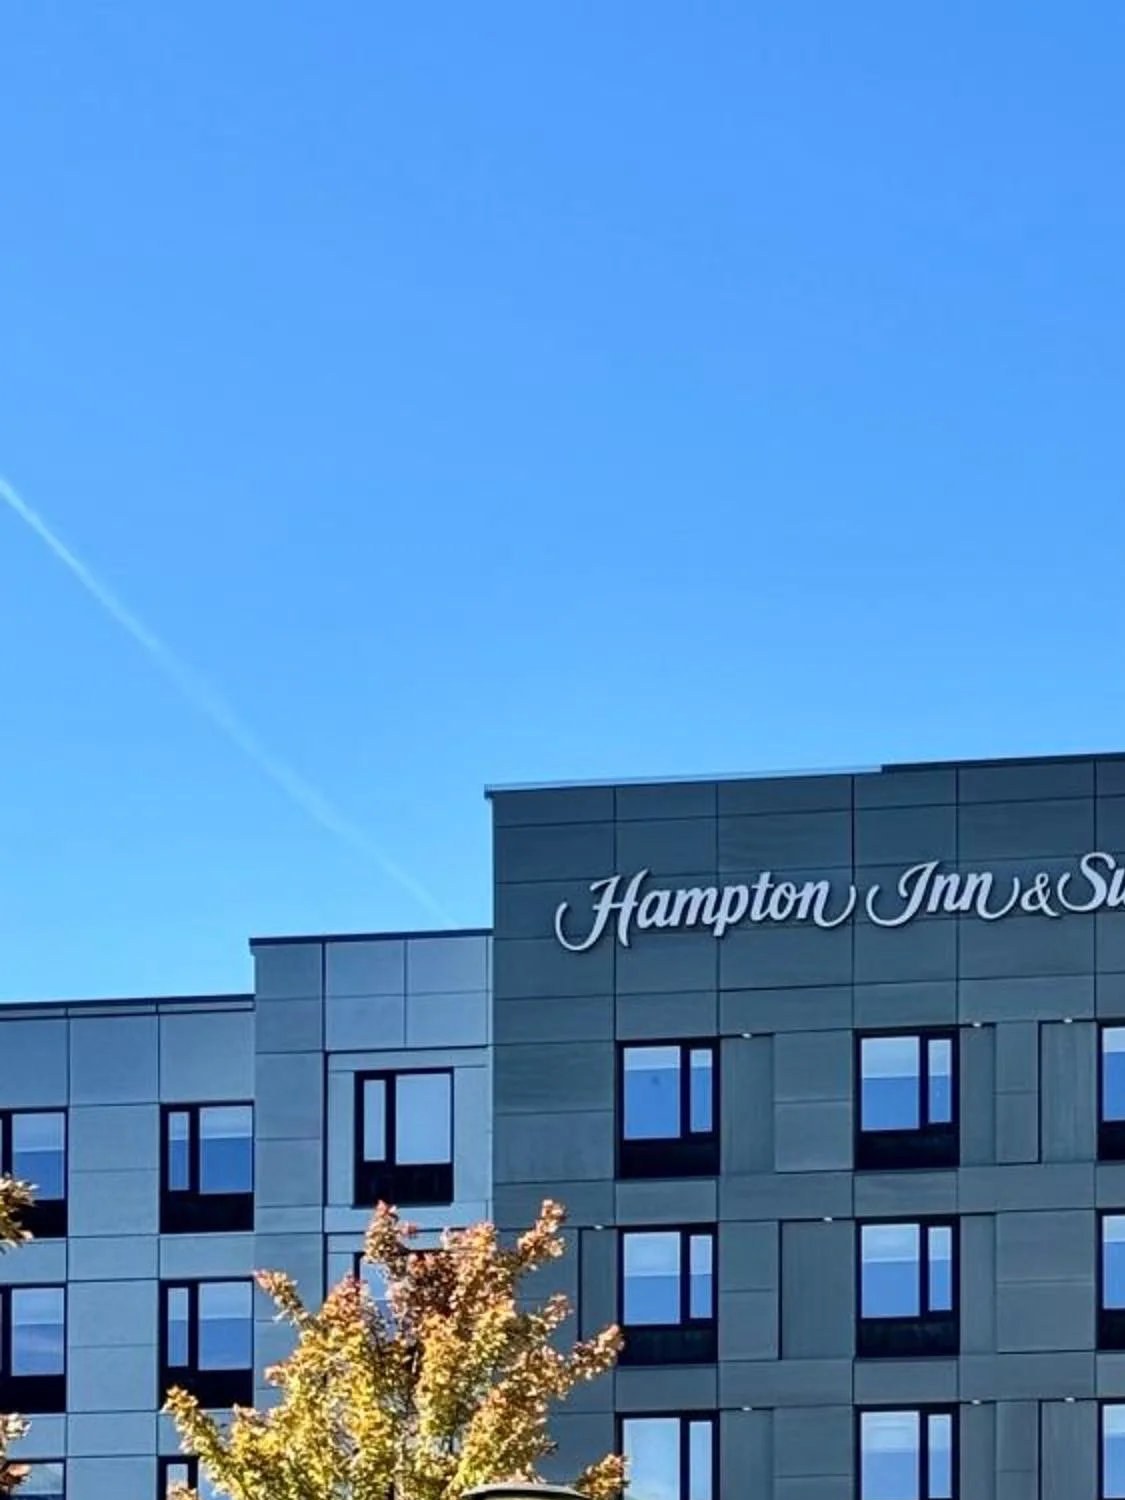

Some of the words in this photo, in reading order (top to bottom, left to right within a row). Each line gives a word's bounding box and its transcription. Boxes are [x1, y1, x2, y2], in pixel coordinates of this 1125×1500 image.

[555, 868, 857, 951] Hampton
[865, 860, 1020, 927] Inn
[1020, 872, 1061, 918] &
